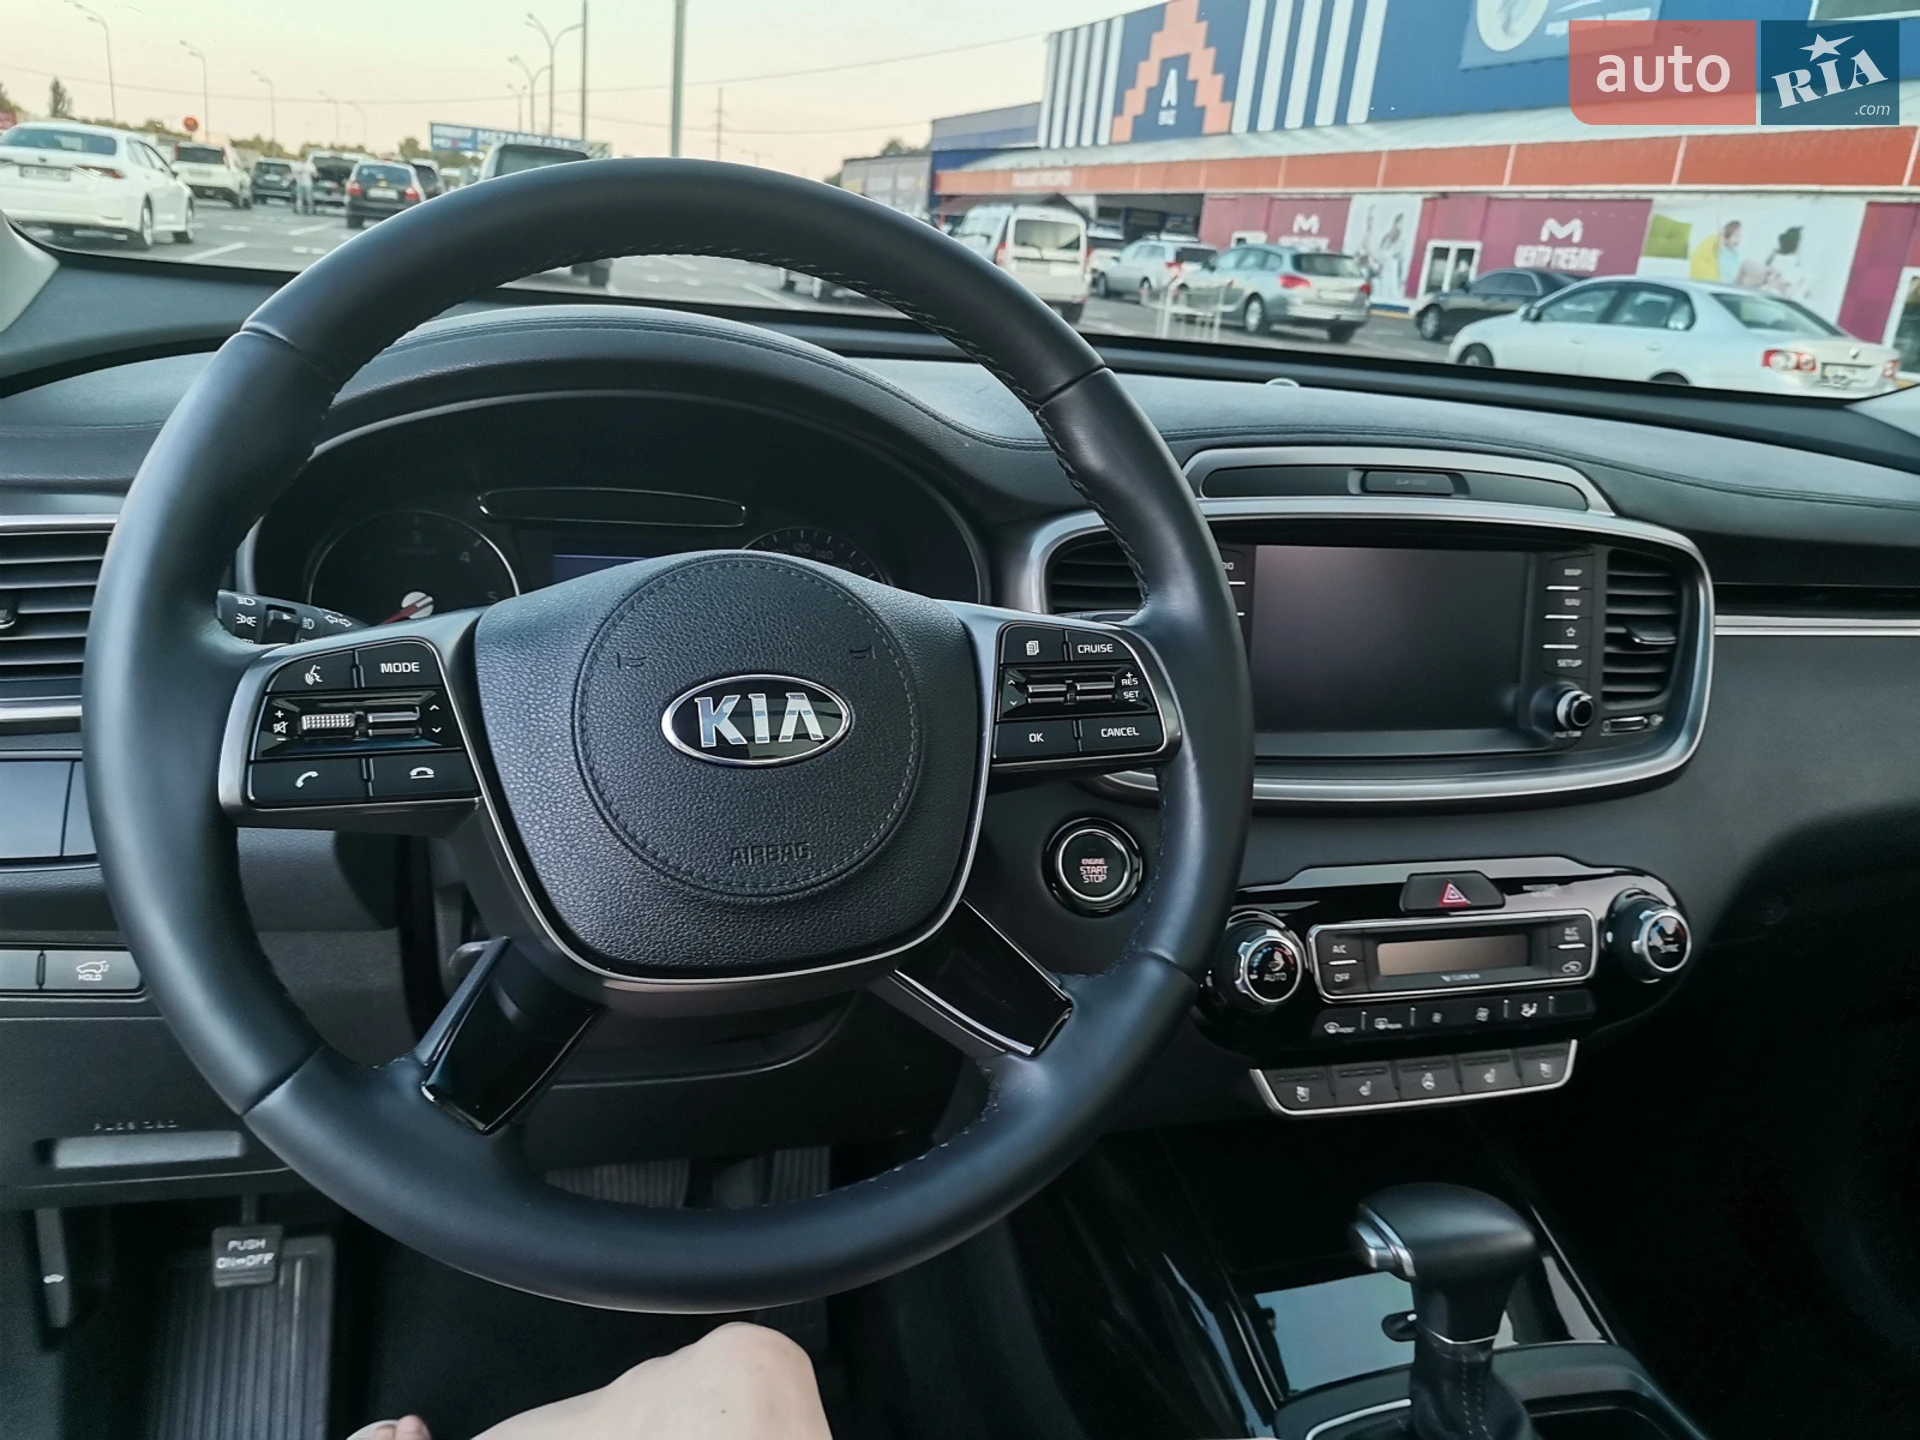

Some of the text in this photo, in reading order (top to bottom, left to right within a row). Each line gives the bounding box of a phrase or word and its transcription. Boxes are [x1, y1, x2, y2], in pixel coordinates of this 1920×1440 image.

[1077, 643, 1114, 654] CRUISE
[380, 662, 420, 673] MODE
[1121, 677, 1139, 686] RES
[1123, 690, 1140, 699] SET
[694, 692, 825, 748] KIA
[1101, 726, 1140, 738] CANCEL
[1028, 733, 1045, 743] OK
[730, 843, 812, 866] AIRBAG
[1080, 866, 1108, 875] START
[1082, 875, 1107, 883] STOP
[1332, 945, 1347, 954] A/C
[1263, 972, 1287, 982] AUTO
[1334, 973, 1350, 983] OFF
[227, 1239, 266, 1251] PUSH
